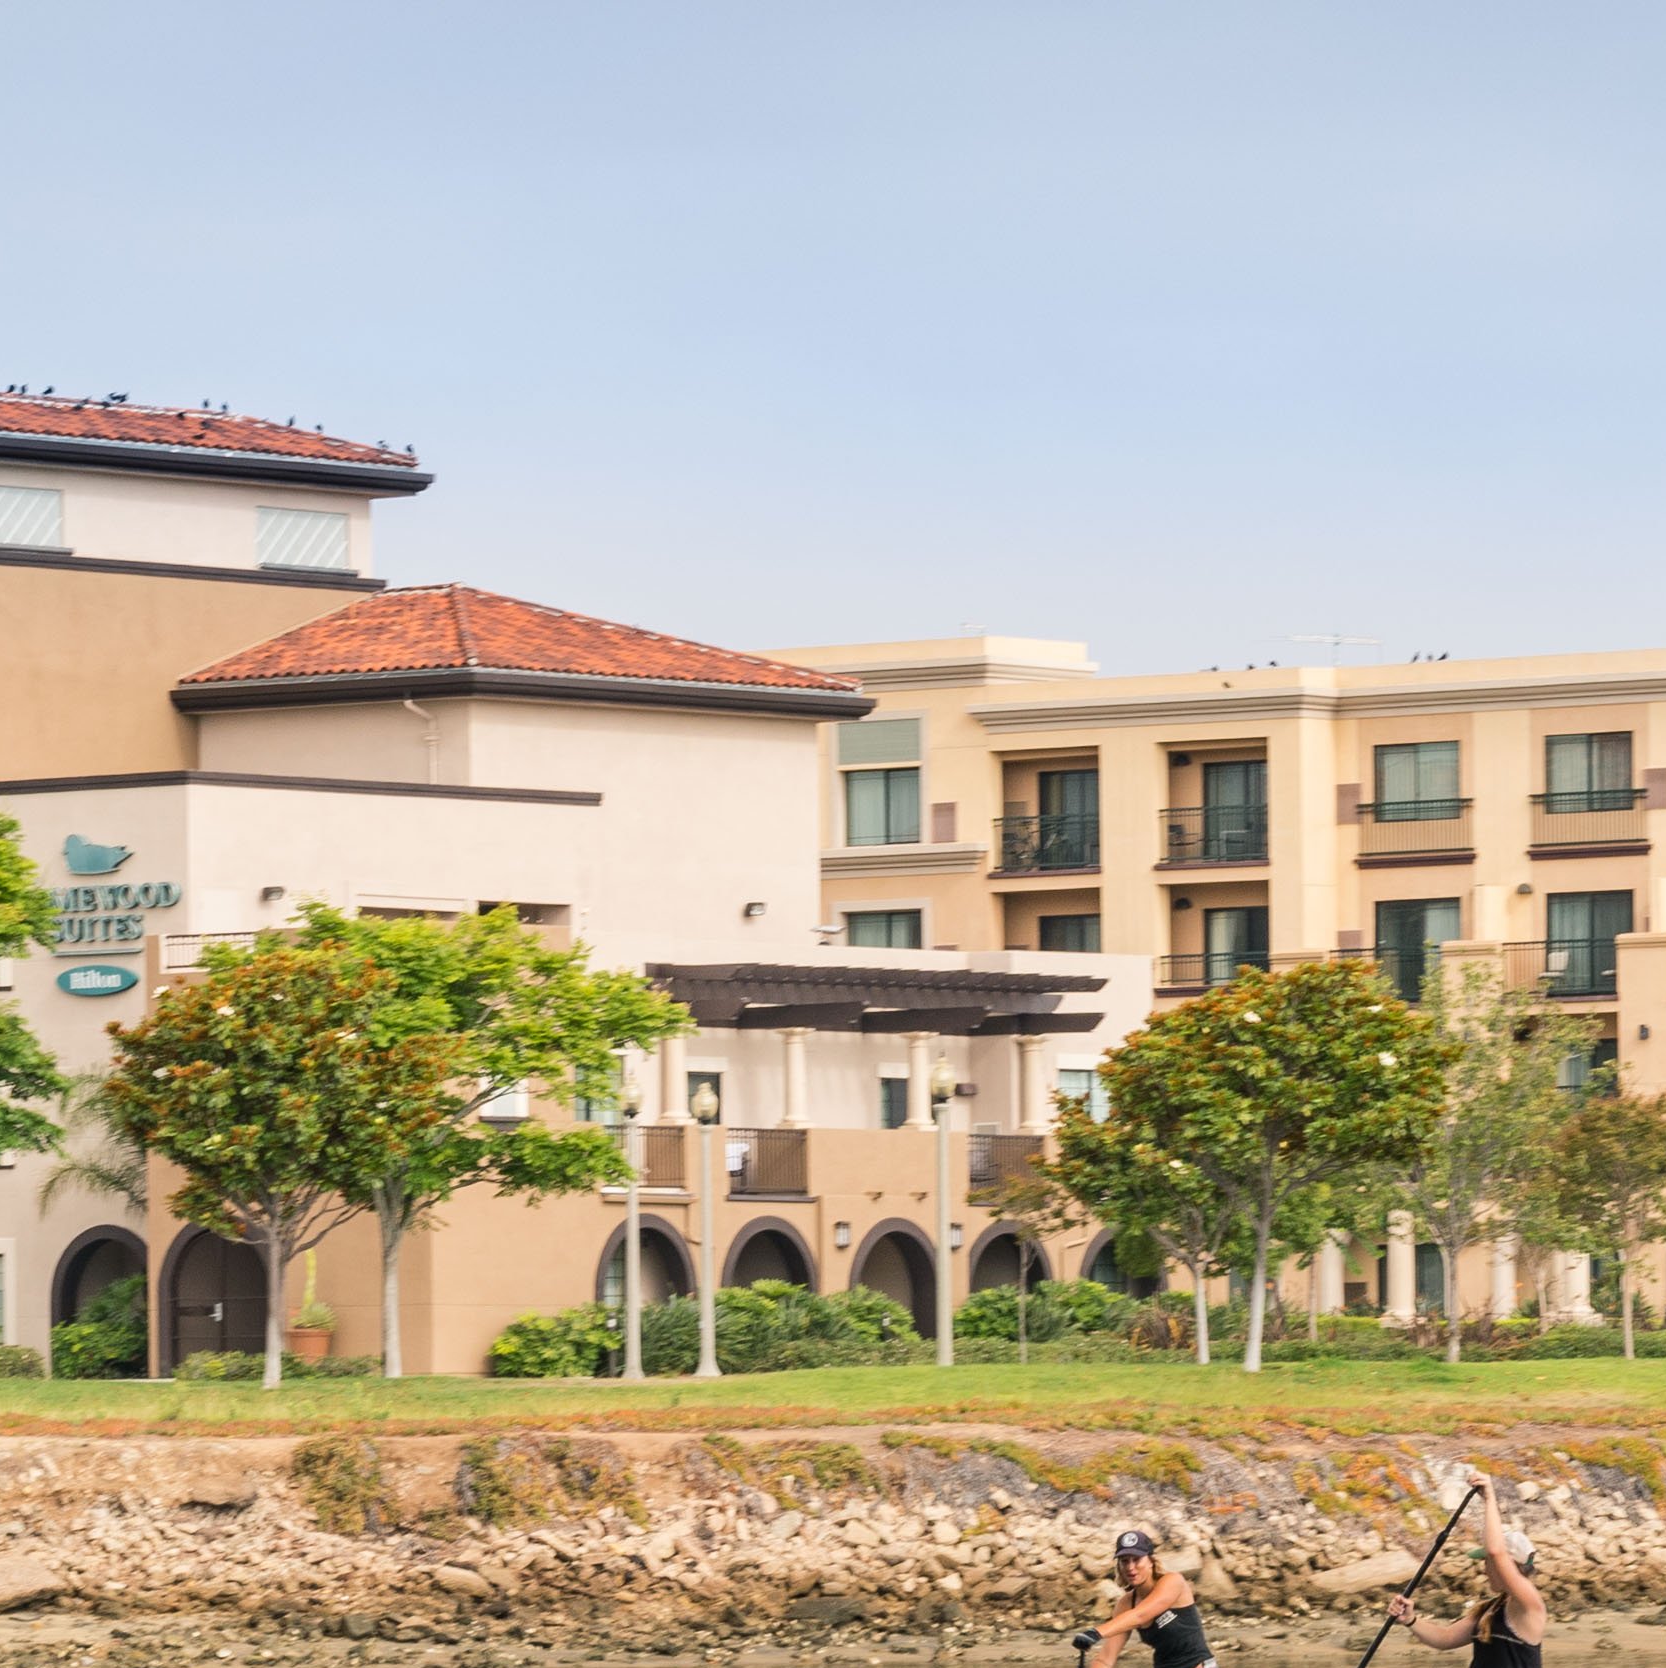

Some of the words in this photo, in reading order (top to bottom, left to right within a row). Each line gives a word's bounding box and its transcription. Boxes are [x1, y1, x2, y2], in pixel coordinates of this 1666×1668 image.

[52, 882, 181, 913] MEWOOD
[53, 915, 144, 943] SUITES
[70, 970, 122, 989] Hilton
